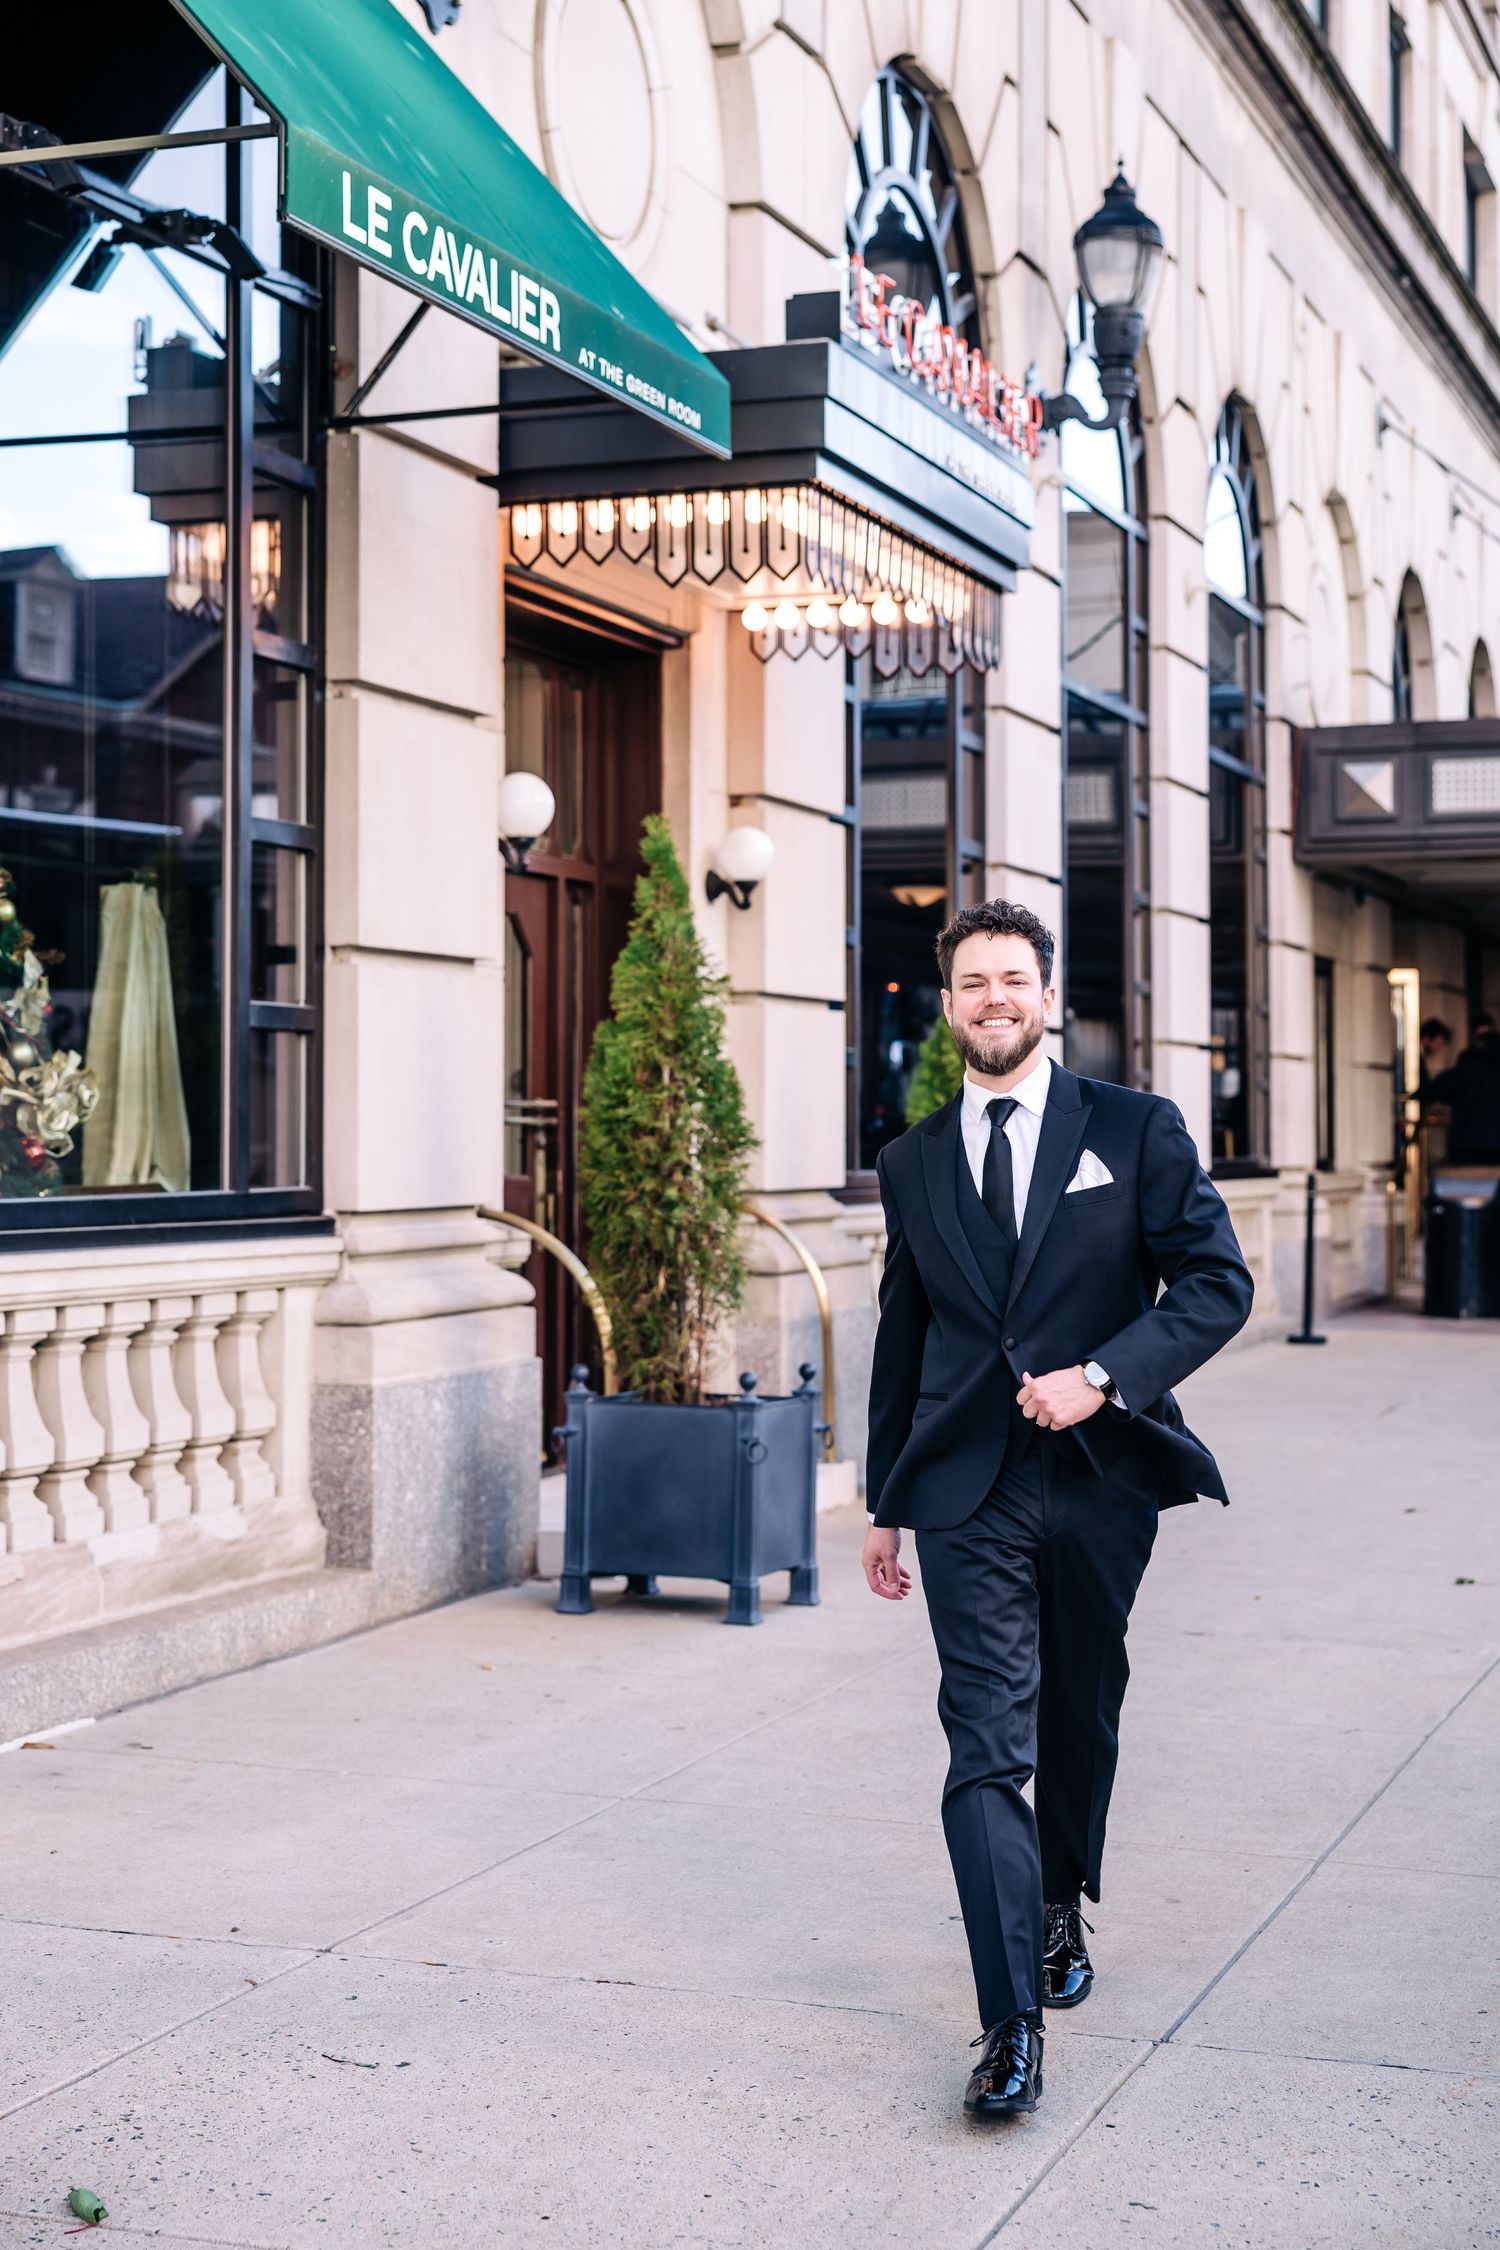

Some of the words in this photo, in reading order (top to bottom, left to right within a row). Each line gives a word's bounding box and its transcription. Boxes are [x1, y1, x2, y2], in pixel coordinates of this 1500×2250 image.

[342, 170, 393, 259] LE
[402, 210, 561, 353] CAVALIER
[578, 347, 597, 371] AT
[598, 357, 624, 387] THE
[625, 373, 667, 411] GREEN
[667, 397, 702, 430] ROOM
[843, 253, 897, 352] LE
[890, 297, 1043, 460] CAVALIER
